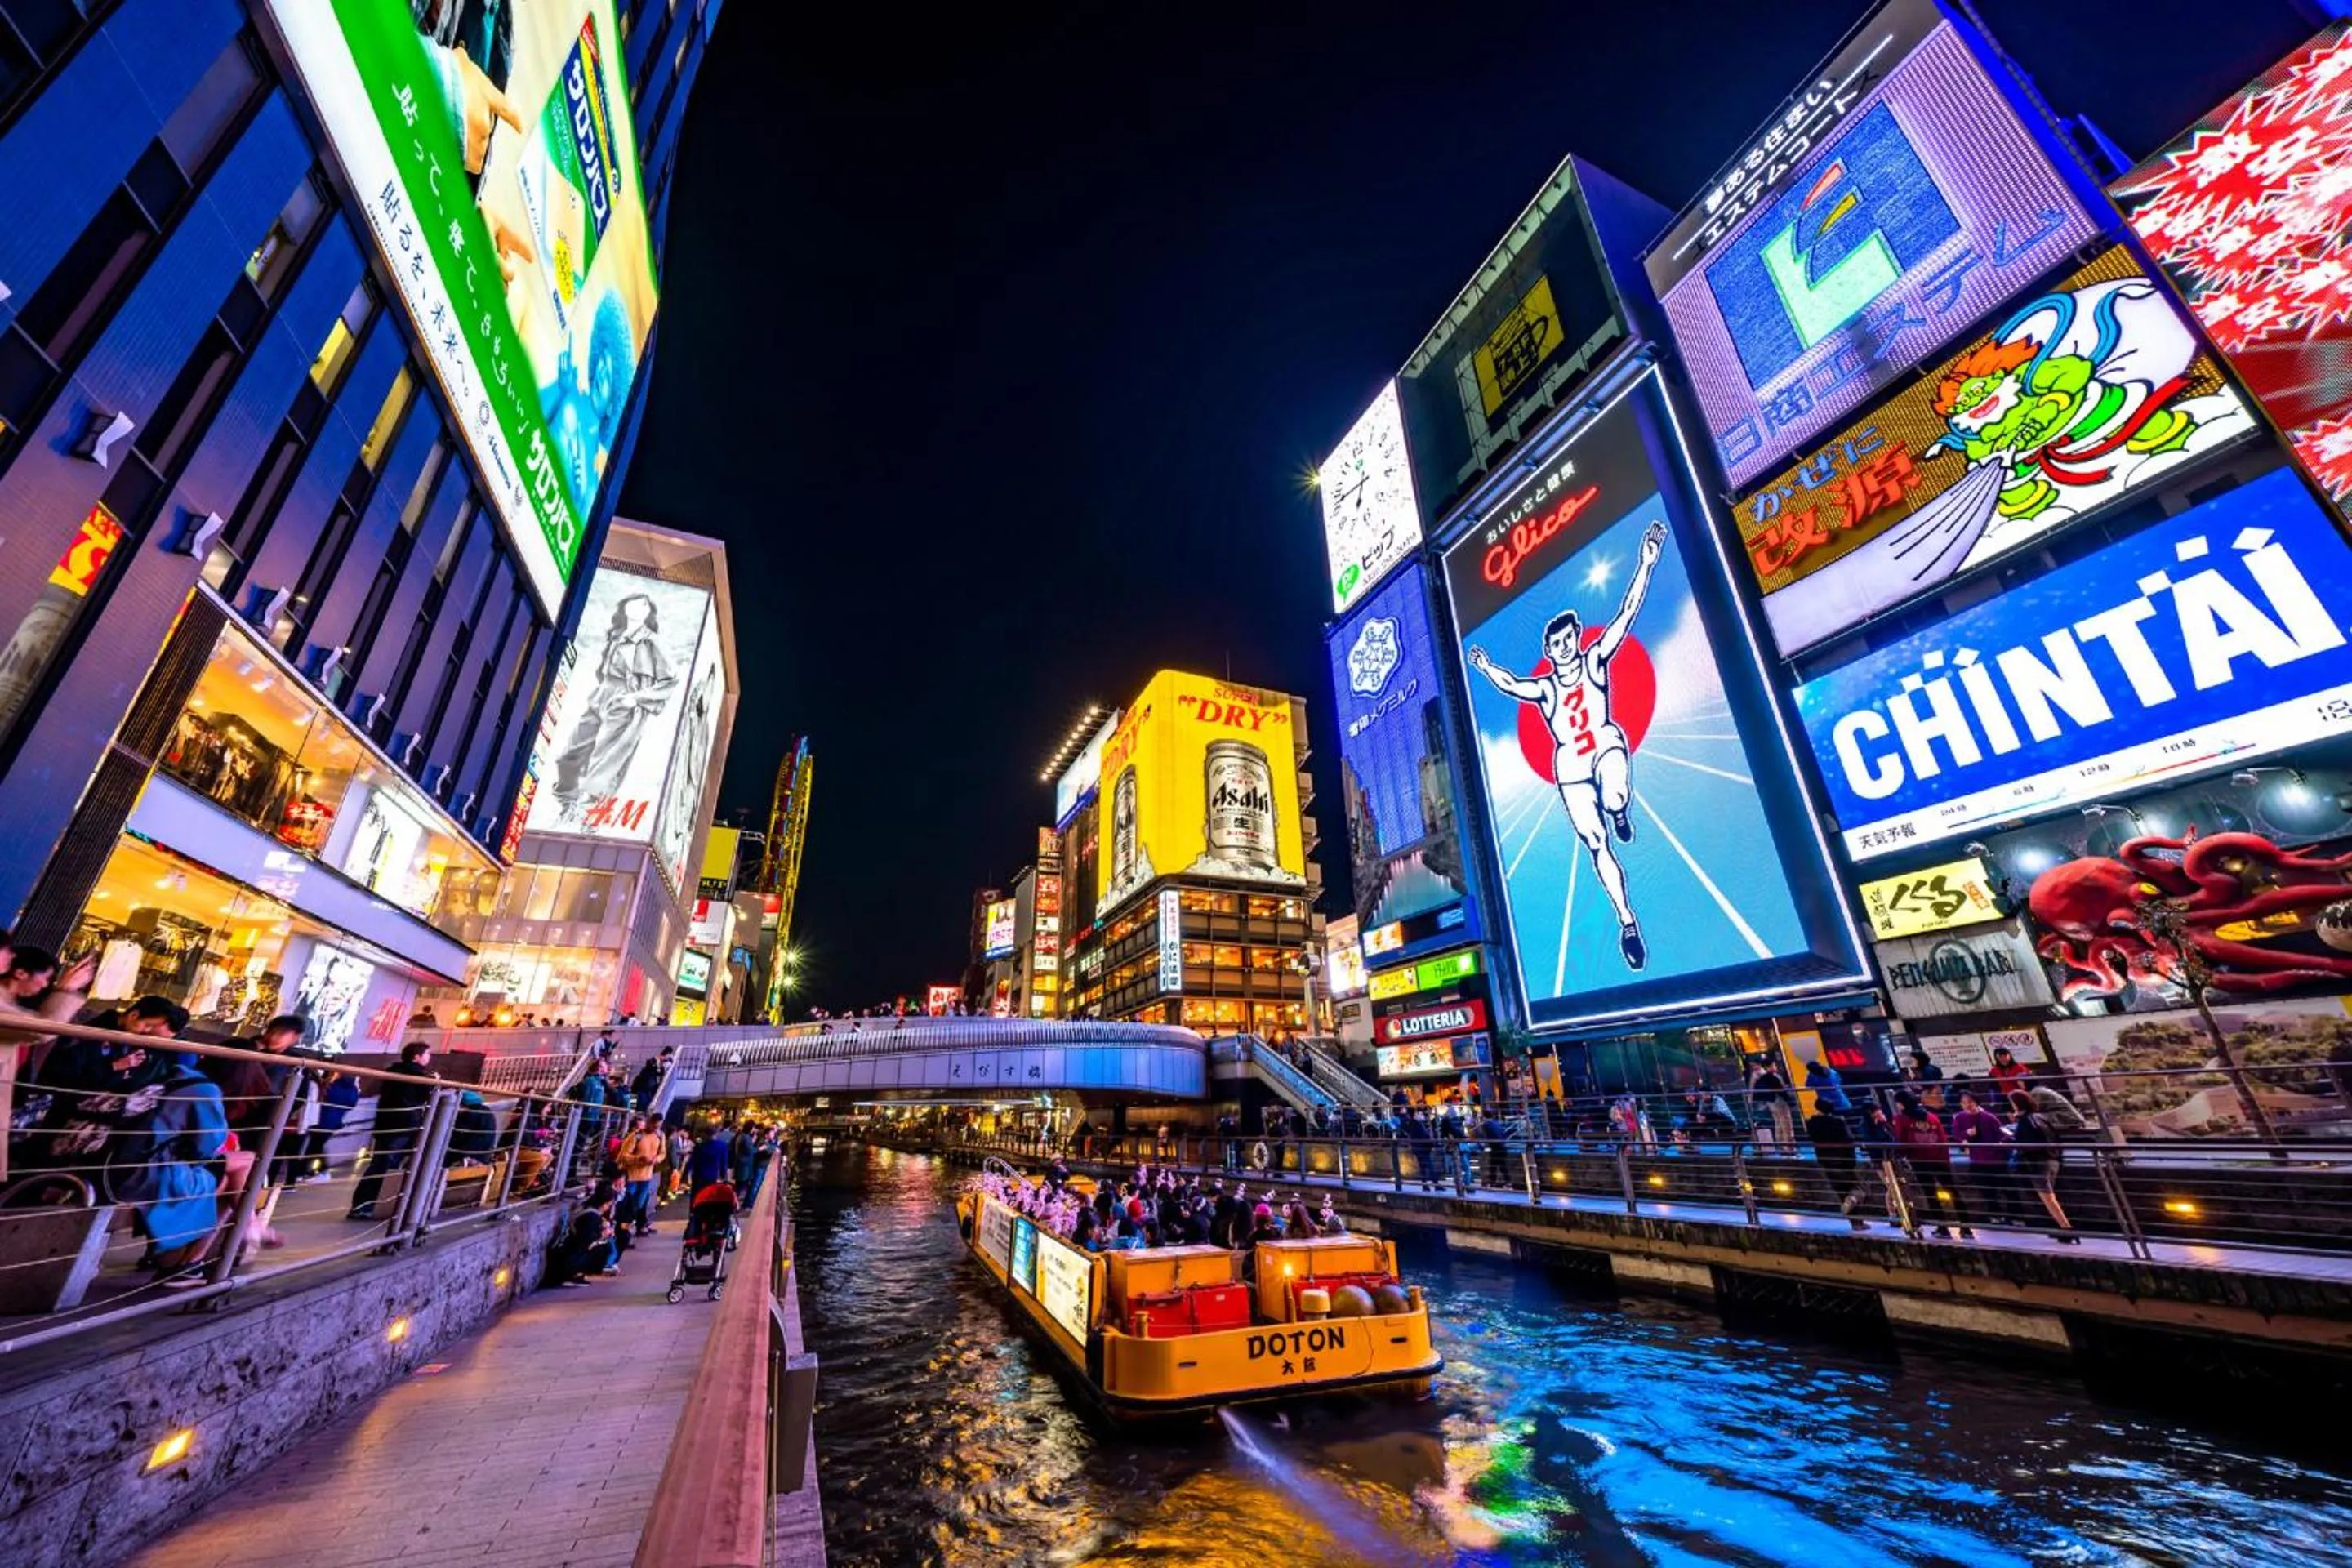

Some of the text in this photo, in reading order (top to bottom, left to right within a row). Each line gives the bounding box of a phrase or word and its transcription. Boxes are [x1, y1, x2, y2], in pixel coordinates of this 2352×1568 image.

[568, 58, 608, 234] サロンパス
[1705, 91, 1858, 245] エステムコート
[1718, 208, 2065, 467] 日商エステム
[526, 427, 576, 568] サロンパス
[1486, 460, 1575, 545] おいしさと健康
[1746, 439, 1922, 577] 改源
[1749, 425, 1885, 523] かぜに
[1361, 525, 1396, 572] ピップ
[1484, 486, 1597, 587] Glico
[1214, 688, 1261, 707] SUPER
[1832, 527, 2347, 800] CHINTAI
[1562, 684, 1597, 757] グリコ
[583, 794, 649, 831] H&M
[1212, 782, 1269, 814] Asahi
[1859, 822, 1917, 849] 天気予報
[1402, 1009, 1466, 1034] LOTTERIA
[1246, 1326, 1345, 1360] DOTON
